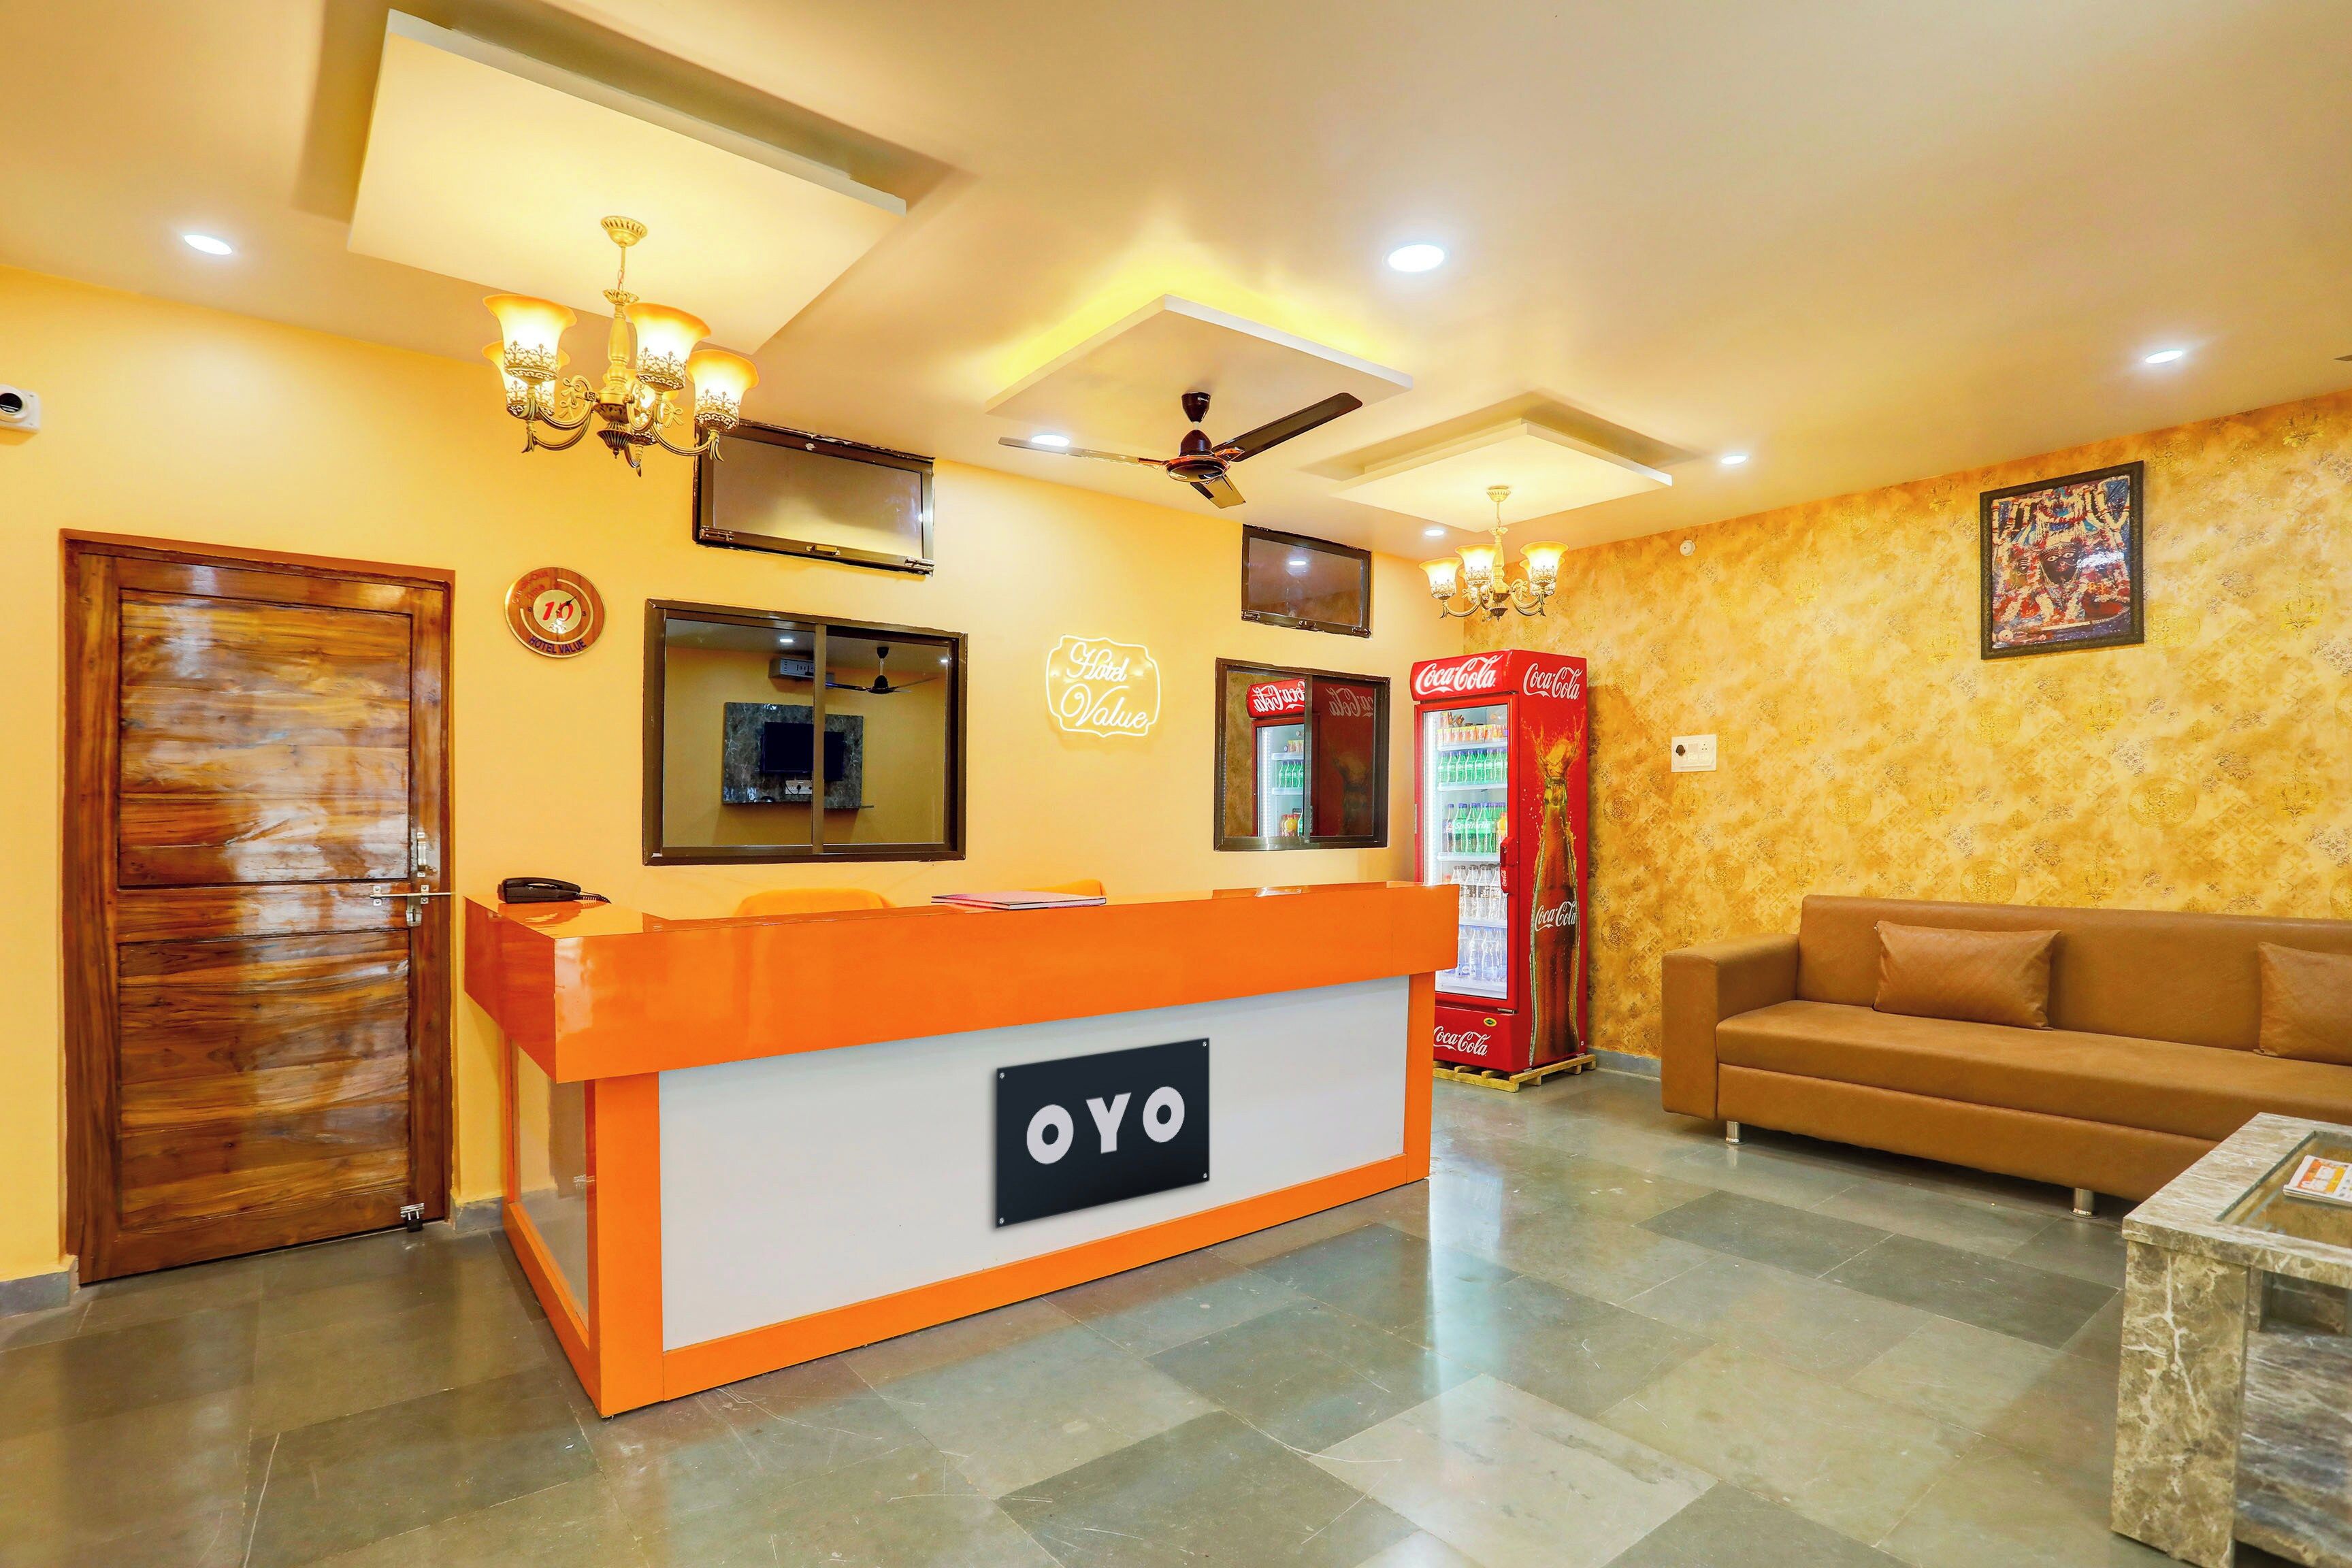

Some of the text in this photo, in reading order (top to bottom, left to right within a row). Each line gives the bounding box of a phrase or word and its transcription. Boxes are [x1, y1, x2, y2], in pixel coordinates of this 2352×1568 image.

[542, 602, 574, 622] 10
[528, 636, 587, 654] HOTEL VALUE
[1066, 641, 1130, 682] Hotel
[1414, 653, 1503, 695] Coca-Cola
[1522, 662, 1583, 700] Coca-Cola
[1060, 683, 1148, 729] Value
[1534, 900, 1577, 932] Coca-Cola
[1026, 1085, 1186, 1165] OYO
